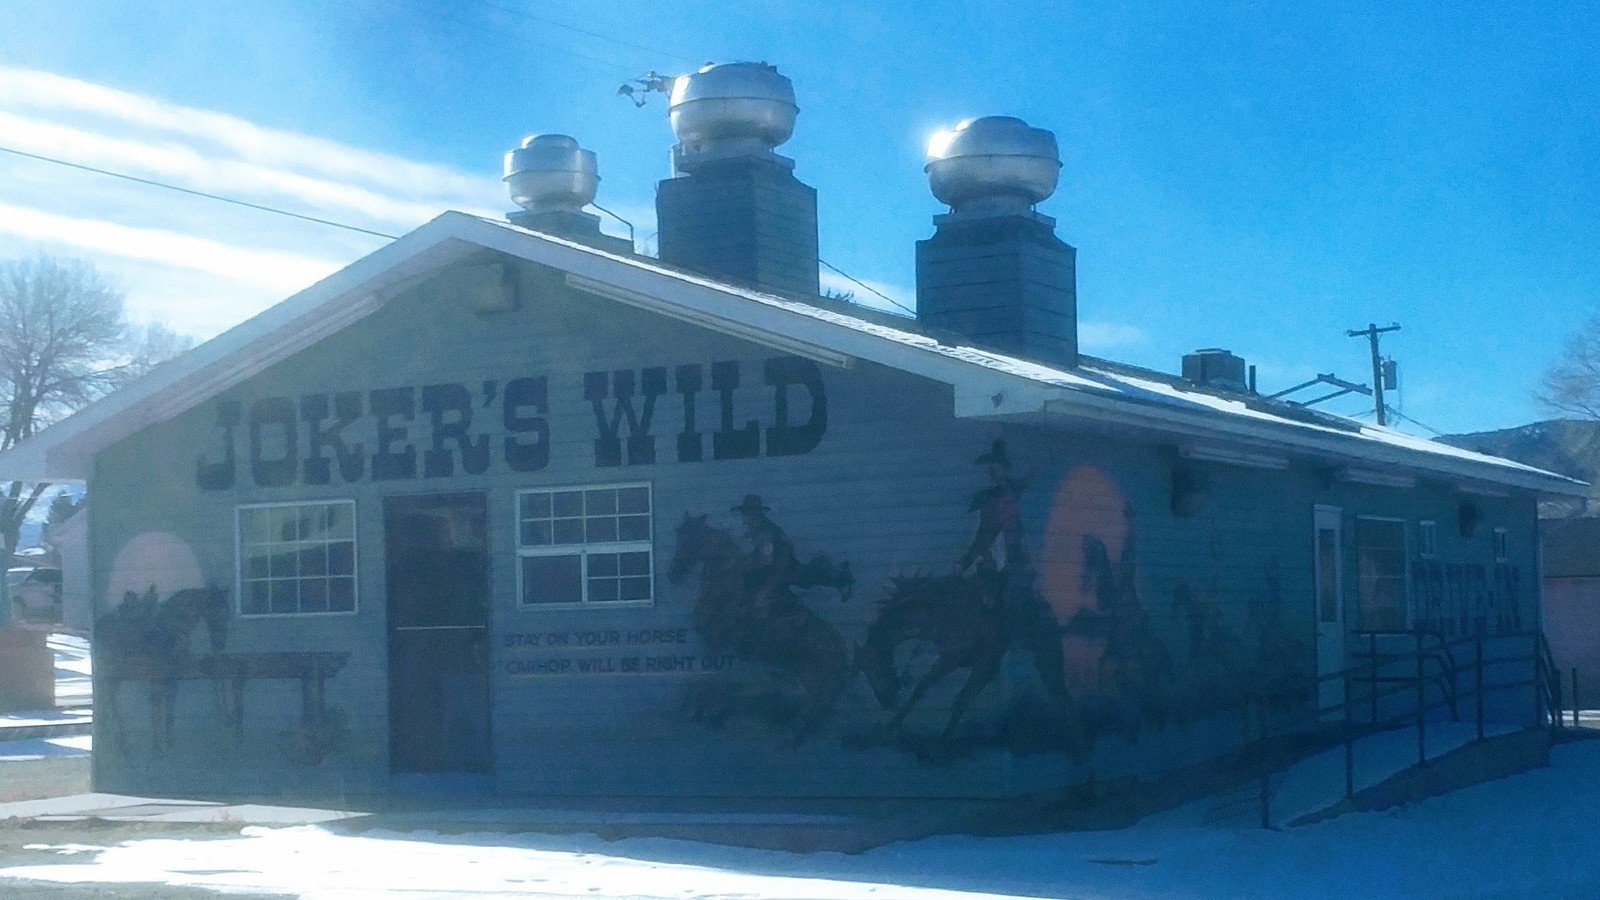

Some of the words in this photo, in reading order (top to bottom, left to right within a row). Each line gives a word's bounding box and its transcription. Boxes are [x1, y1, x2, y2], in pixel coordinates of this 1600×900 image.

[196, 376, 549, 490] JOKER'S
[584, 355, 828, 468] WILD
[504, 633, 541, 647] STAY
[547, 633, 569, 646] ON
[575, 630, 621, 645] YOUR
[627, 629, 689, 644] HORSE
[505, 659, 570, 674] CARHOP
[578, 658, 615, 672] WILL
[620, 657, 640, 672] BE
[645, 656, 696, 671] RIGHT
[700, 655, 737, 670] OUT
